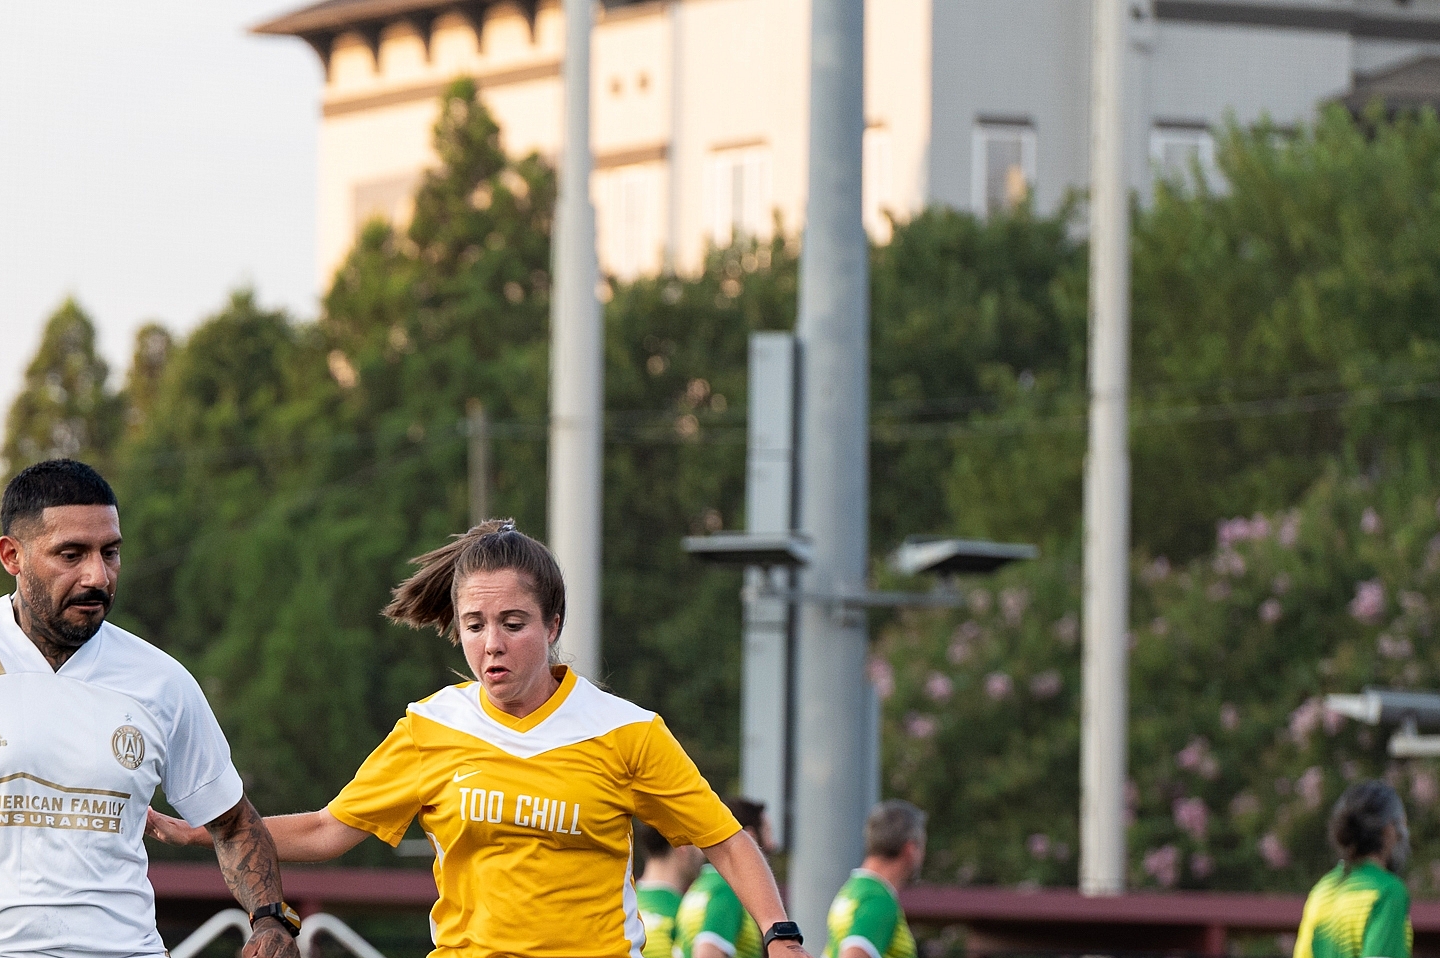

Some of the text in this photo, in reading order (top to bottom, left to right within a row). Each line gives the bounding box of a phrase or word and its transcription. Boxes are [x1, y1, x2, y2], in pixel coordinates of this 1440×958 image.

[70, 798, 125, 816] FAMILY
[459, 787, 581, 835] TOO CHILL
